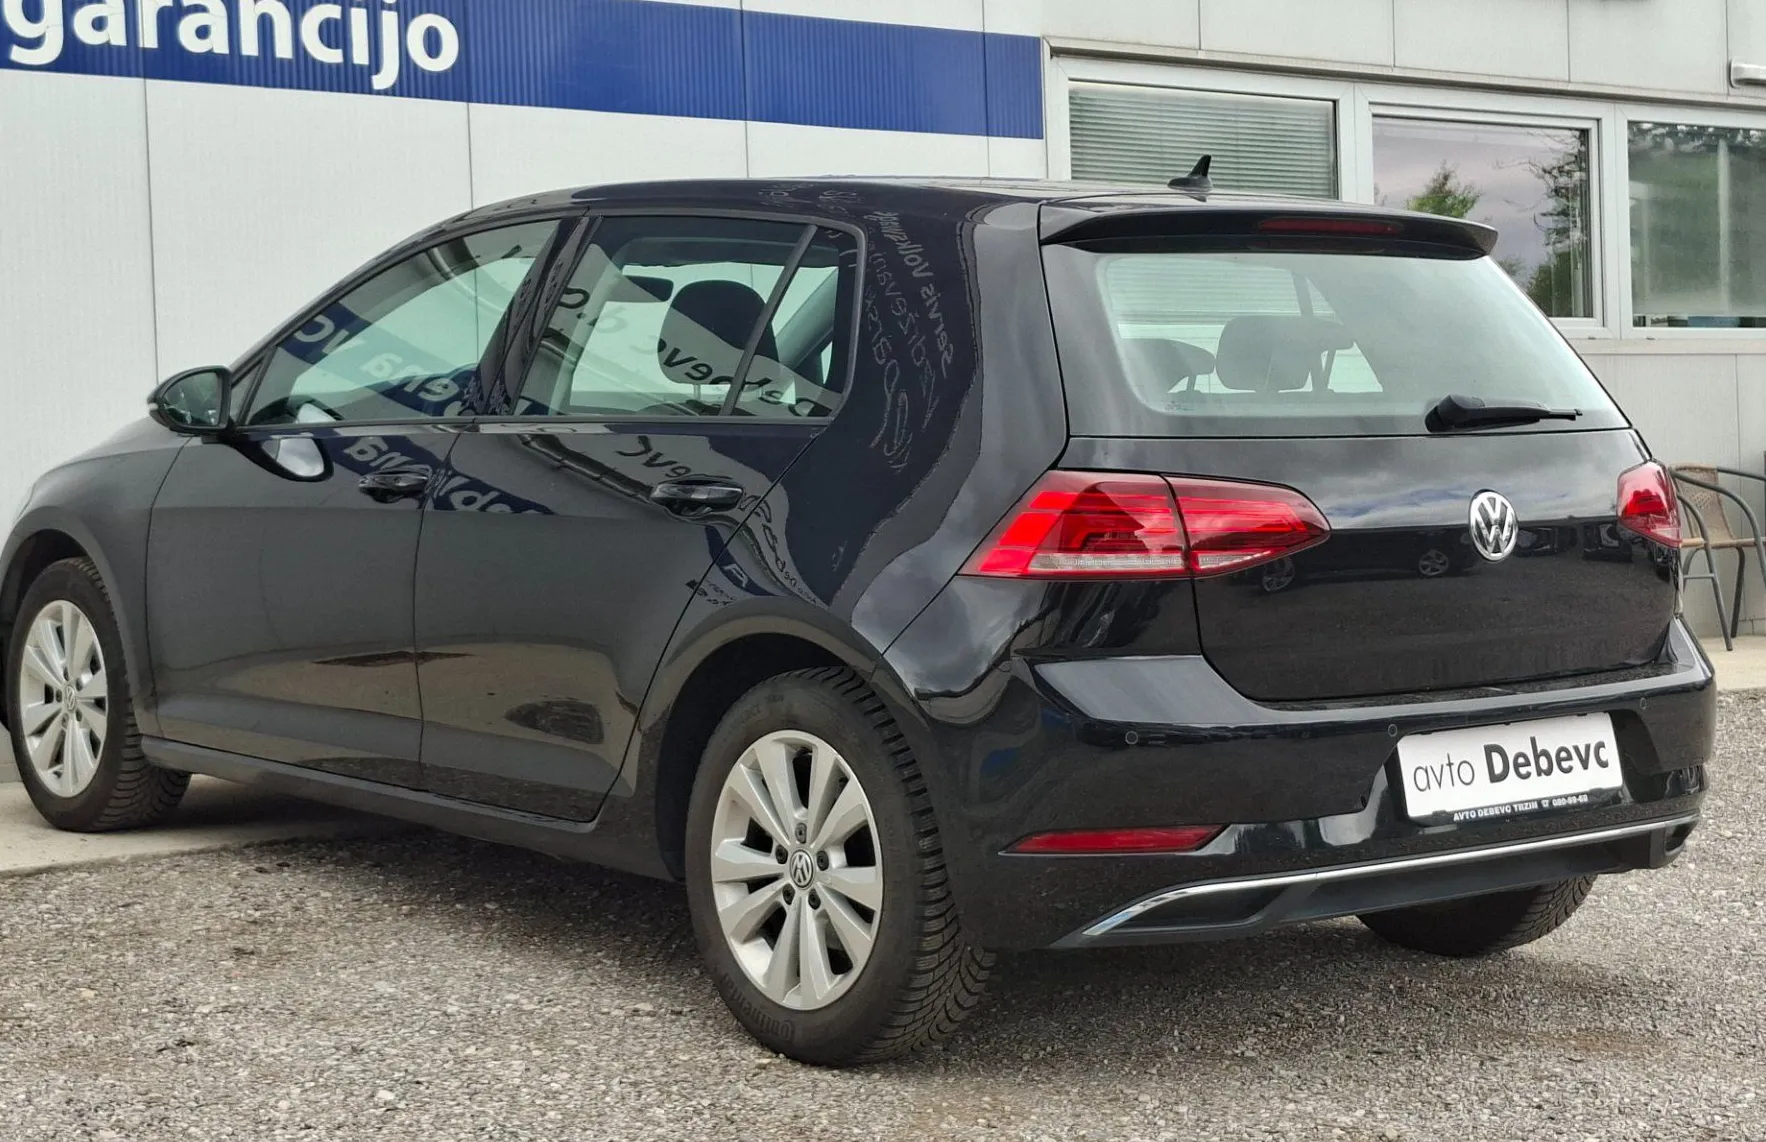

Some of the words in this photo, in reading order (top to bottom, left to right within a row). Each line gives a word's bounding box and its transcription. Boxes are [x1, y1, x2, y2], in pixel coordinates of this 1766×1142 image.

[3, 0, 460, 90] garancijo
[1413, 752, 1475, 792] avto
[1483, 736, 1609, 784] Debevc
[1453, 810, 1477, 821] AVTO
